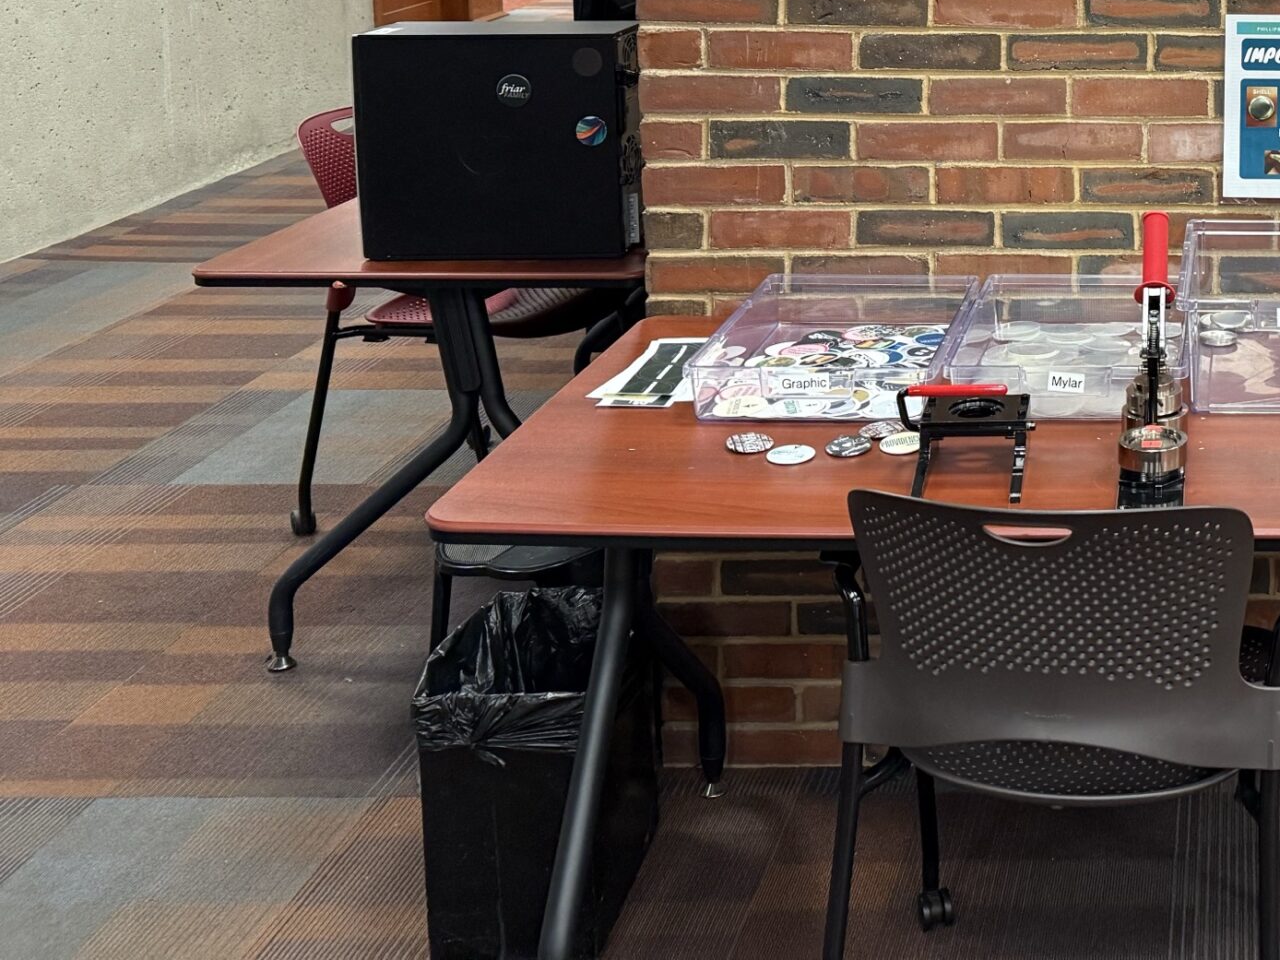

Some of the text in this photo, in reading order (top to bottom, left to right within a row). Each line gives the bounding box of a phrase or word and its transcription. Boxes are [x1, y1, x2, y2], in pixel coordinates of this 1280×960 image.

[499, 82, 526, 95] friar
[781, 377, 827, 391] Graphic
[1051, 375, 1083, 389] Mylar
[882, 434, 920, 448] PROVIDENC
